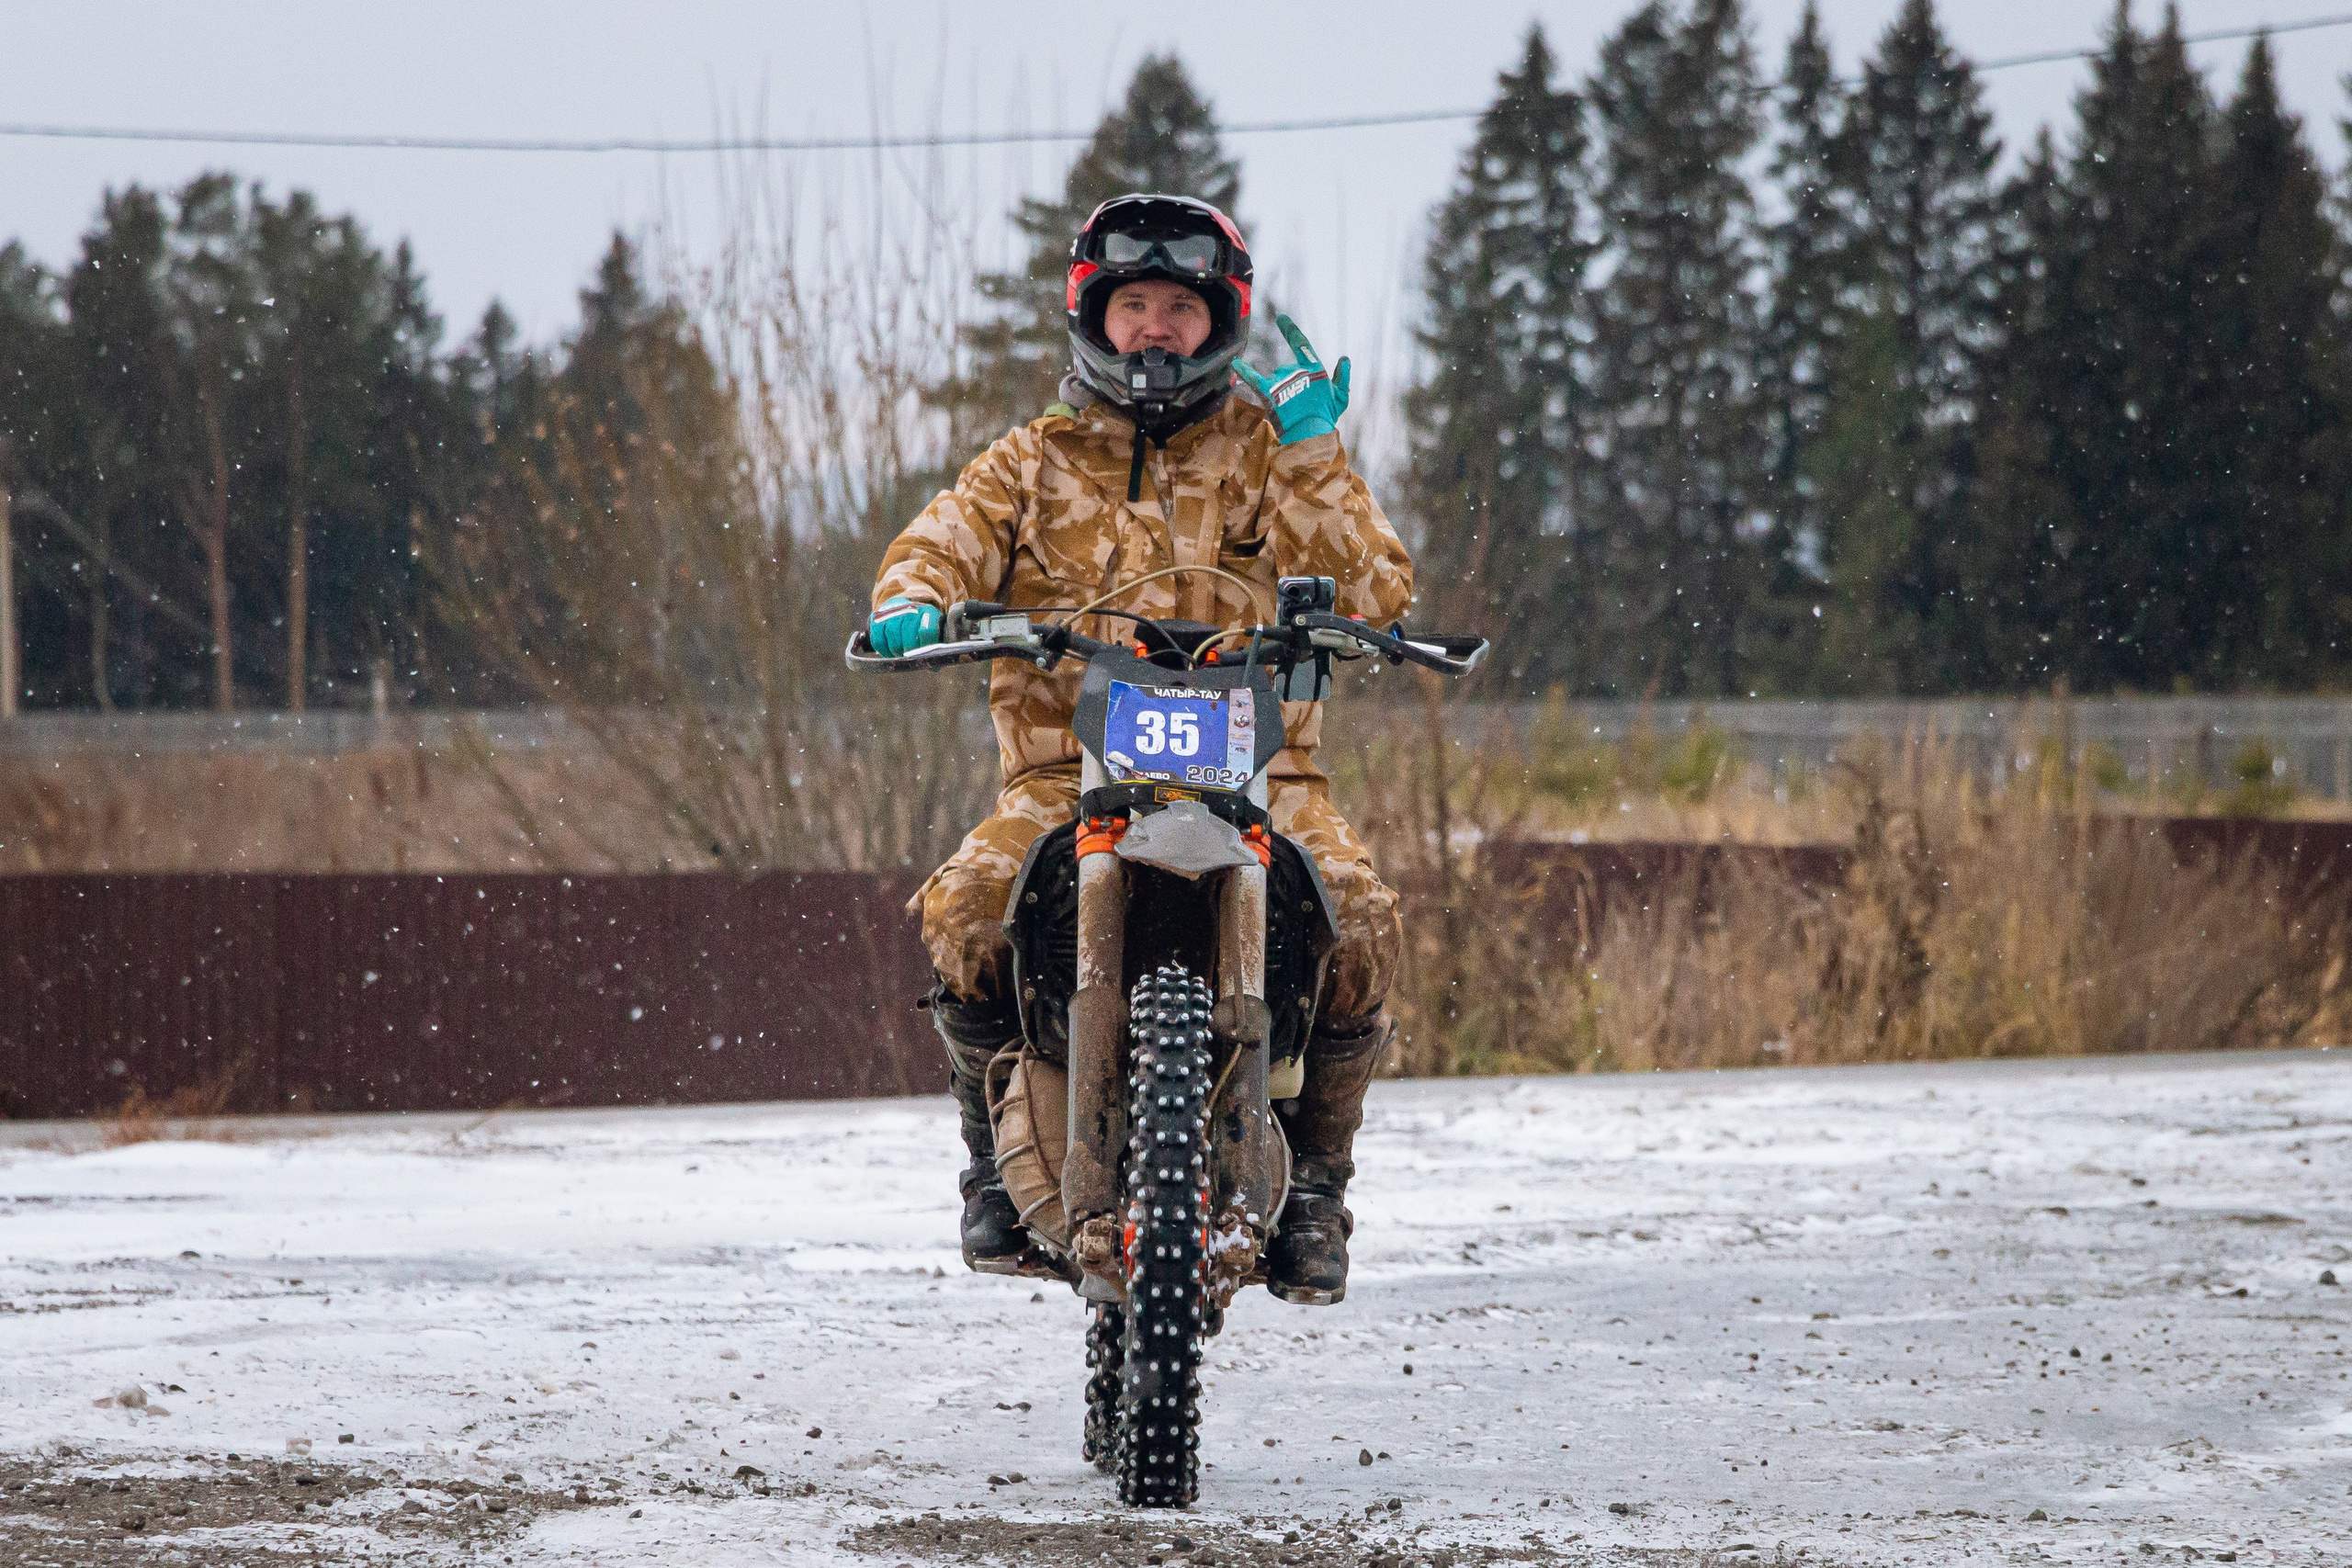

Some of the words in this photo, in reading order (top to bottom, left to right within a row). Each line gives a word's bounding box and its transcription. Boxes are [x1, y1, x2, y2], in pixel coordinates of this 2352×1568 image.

[1154, 687, 1222, 699] ЧАТЫР-ТАУ
[1136, 710, 1200, 756] 35
[1186, 764, 1250, 784] 2024
